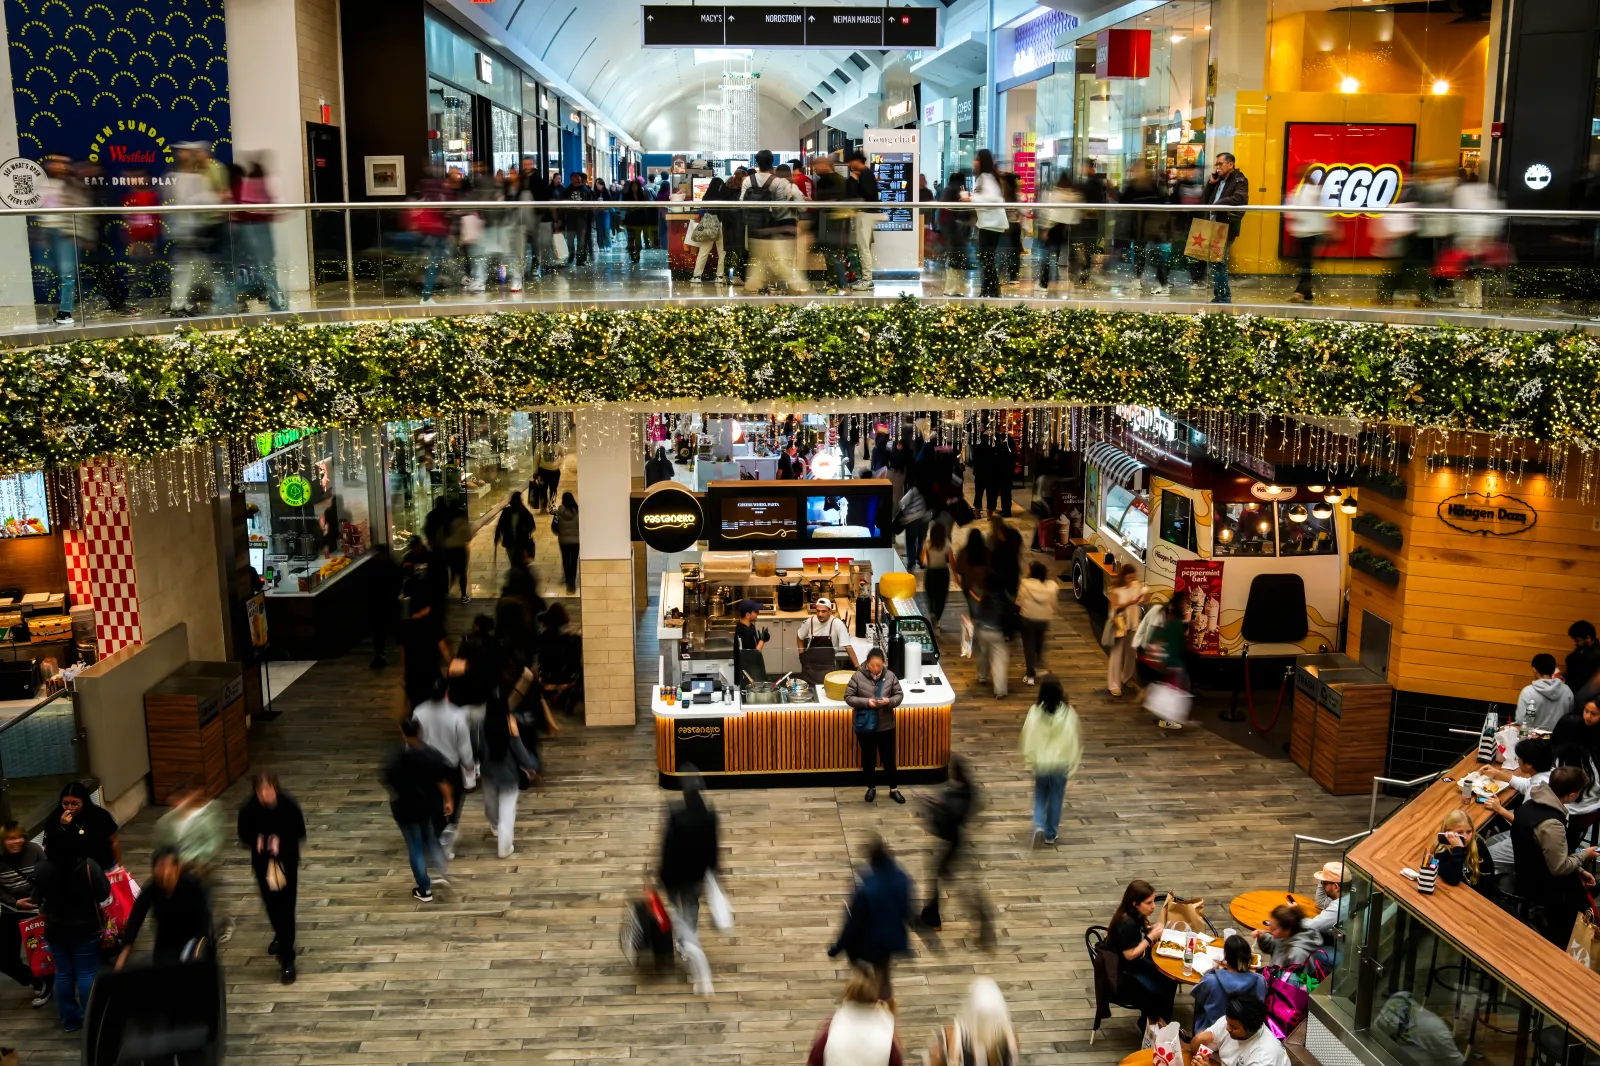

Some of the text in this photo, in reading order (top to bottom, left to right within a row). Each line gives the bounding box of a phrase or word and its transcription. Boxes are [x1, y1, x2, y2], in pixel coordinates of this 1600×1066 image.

[700, 14, 722, 23] MACY'S
[765, 15, 802, 23] NORDSTROM
[833, 16, 882, 24] NEIMAN MARCUS
[89, 120, 174, 164] OPEN SUNDAYS
[868, 134, 910, 146] Gong cha
[108, 145, 156, 163] Westfield
[3, 162, 41, 177] SEE WHAT'S OPEN
[84, 176, 177, 185] EAT. DRINK. PLAY
[7, 194, 41, 206] EVERY SUNDAY
[1448, 504, 1526, 524] Häagen Dazs
[1155, 550, 1177, 565] Häagen-Daz
[1298, 674, 1314, 692] TRASH
